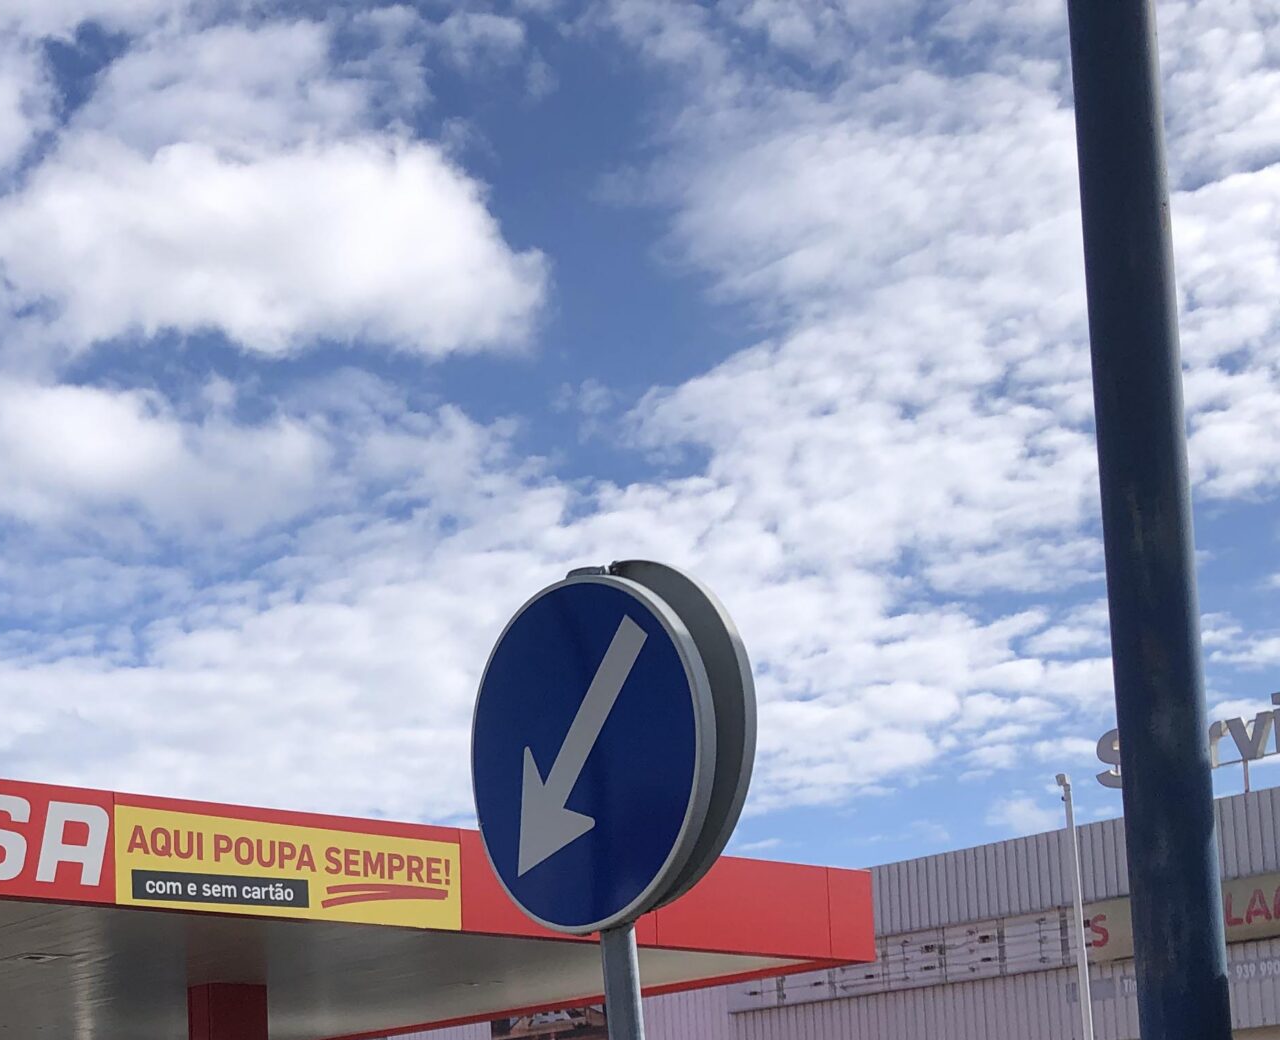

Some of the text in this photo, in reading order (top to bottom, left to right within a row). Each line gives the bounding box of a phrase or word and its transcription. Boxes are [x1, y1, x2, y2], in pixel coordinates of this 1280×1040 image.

[127, 824, 451, 885] AQUI POUPA SEMPRE!
[145, 879, 295, 901] com e sem cartão
